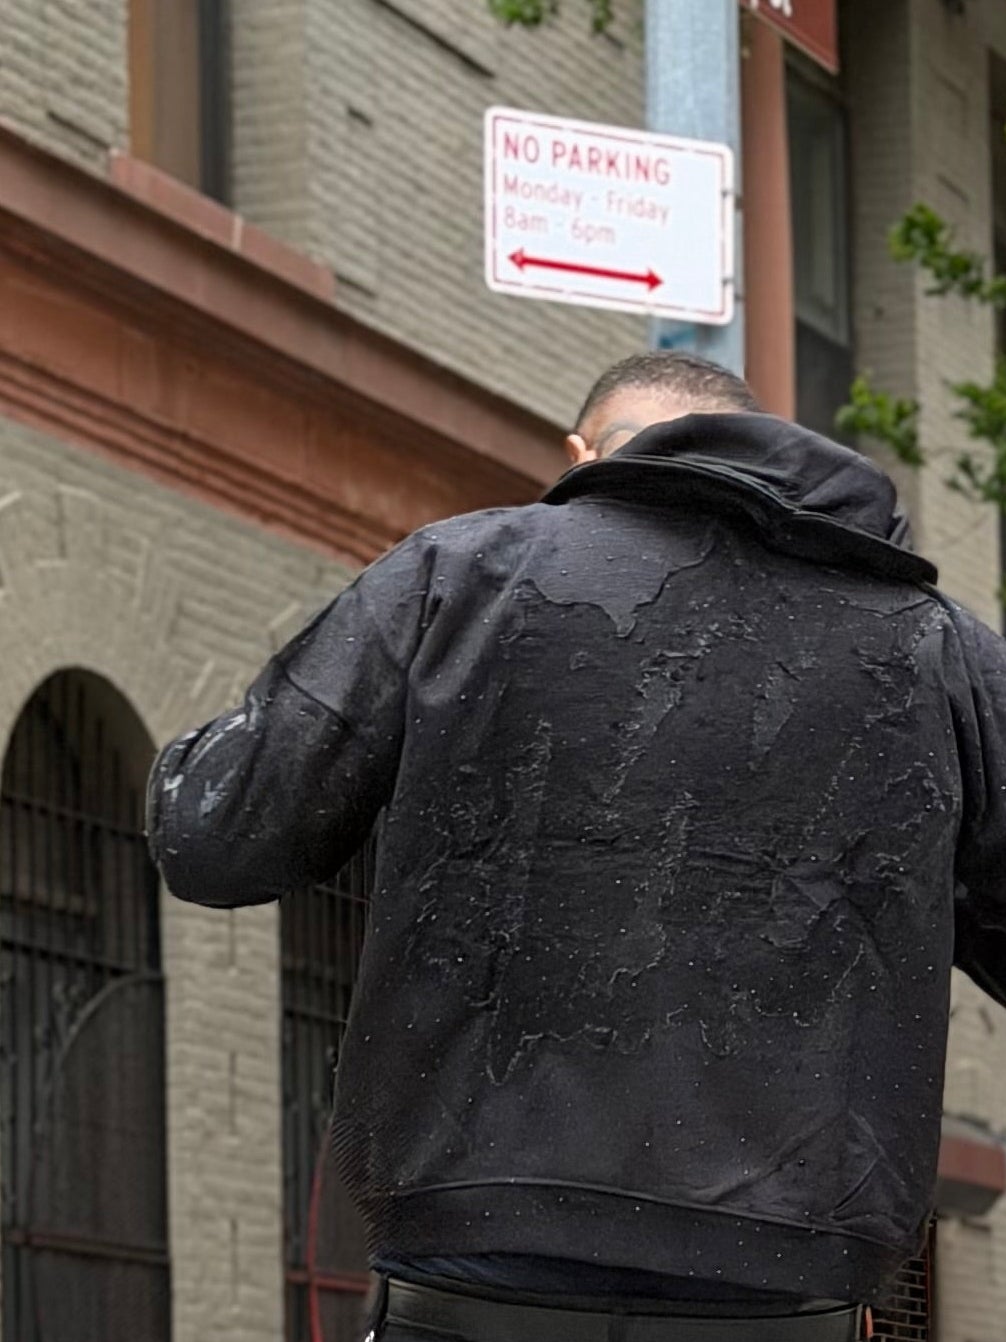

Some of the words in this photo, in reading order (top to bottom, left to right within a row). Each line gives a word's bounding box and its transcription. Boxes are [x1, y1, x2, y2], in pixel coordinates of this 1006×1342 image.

[504, 132, 540, 164] NO
[552, 139, 671, 186] PARKING
[503, 173, 583, 211] Monday
[606, 189, 670, 225] Friday
[503, 204, 548, 231] 8am
[571, 217, 616, 245] 6pm
